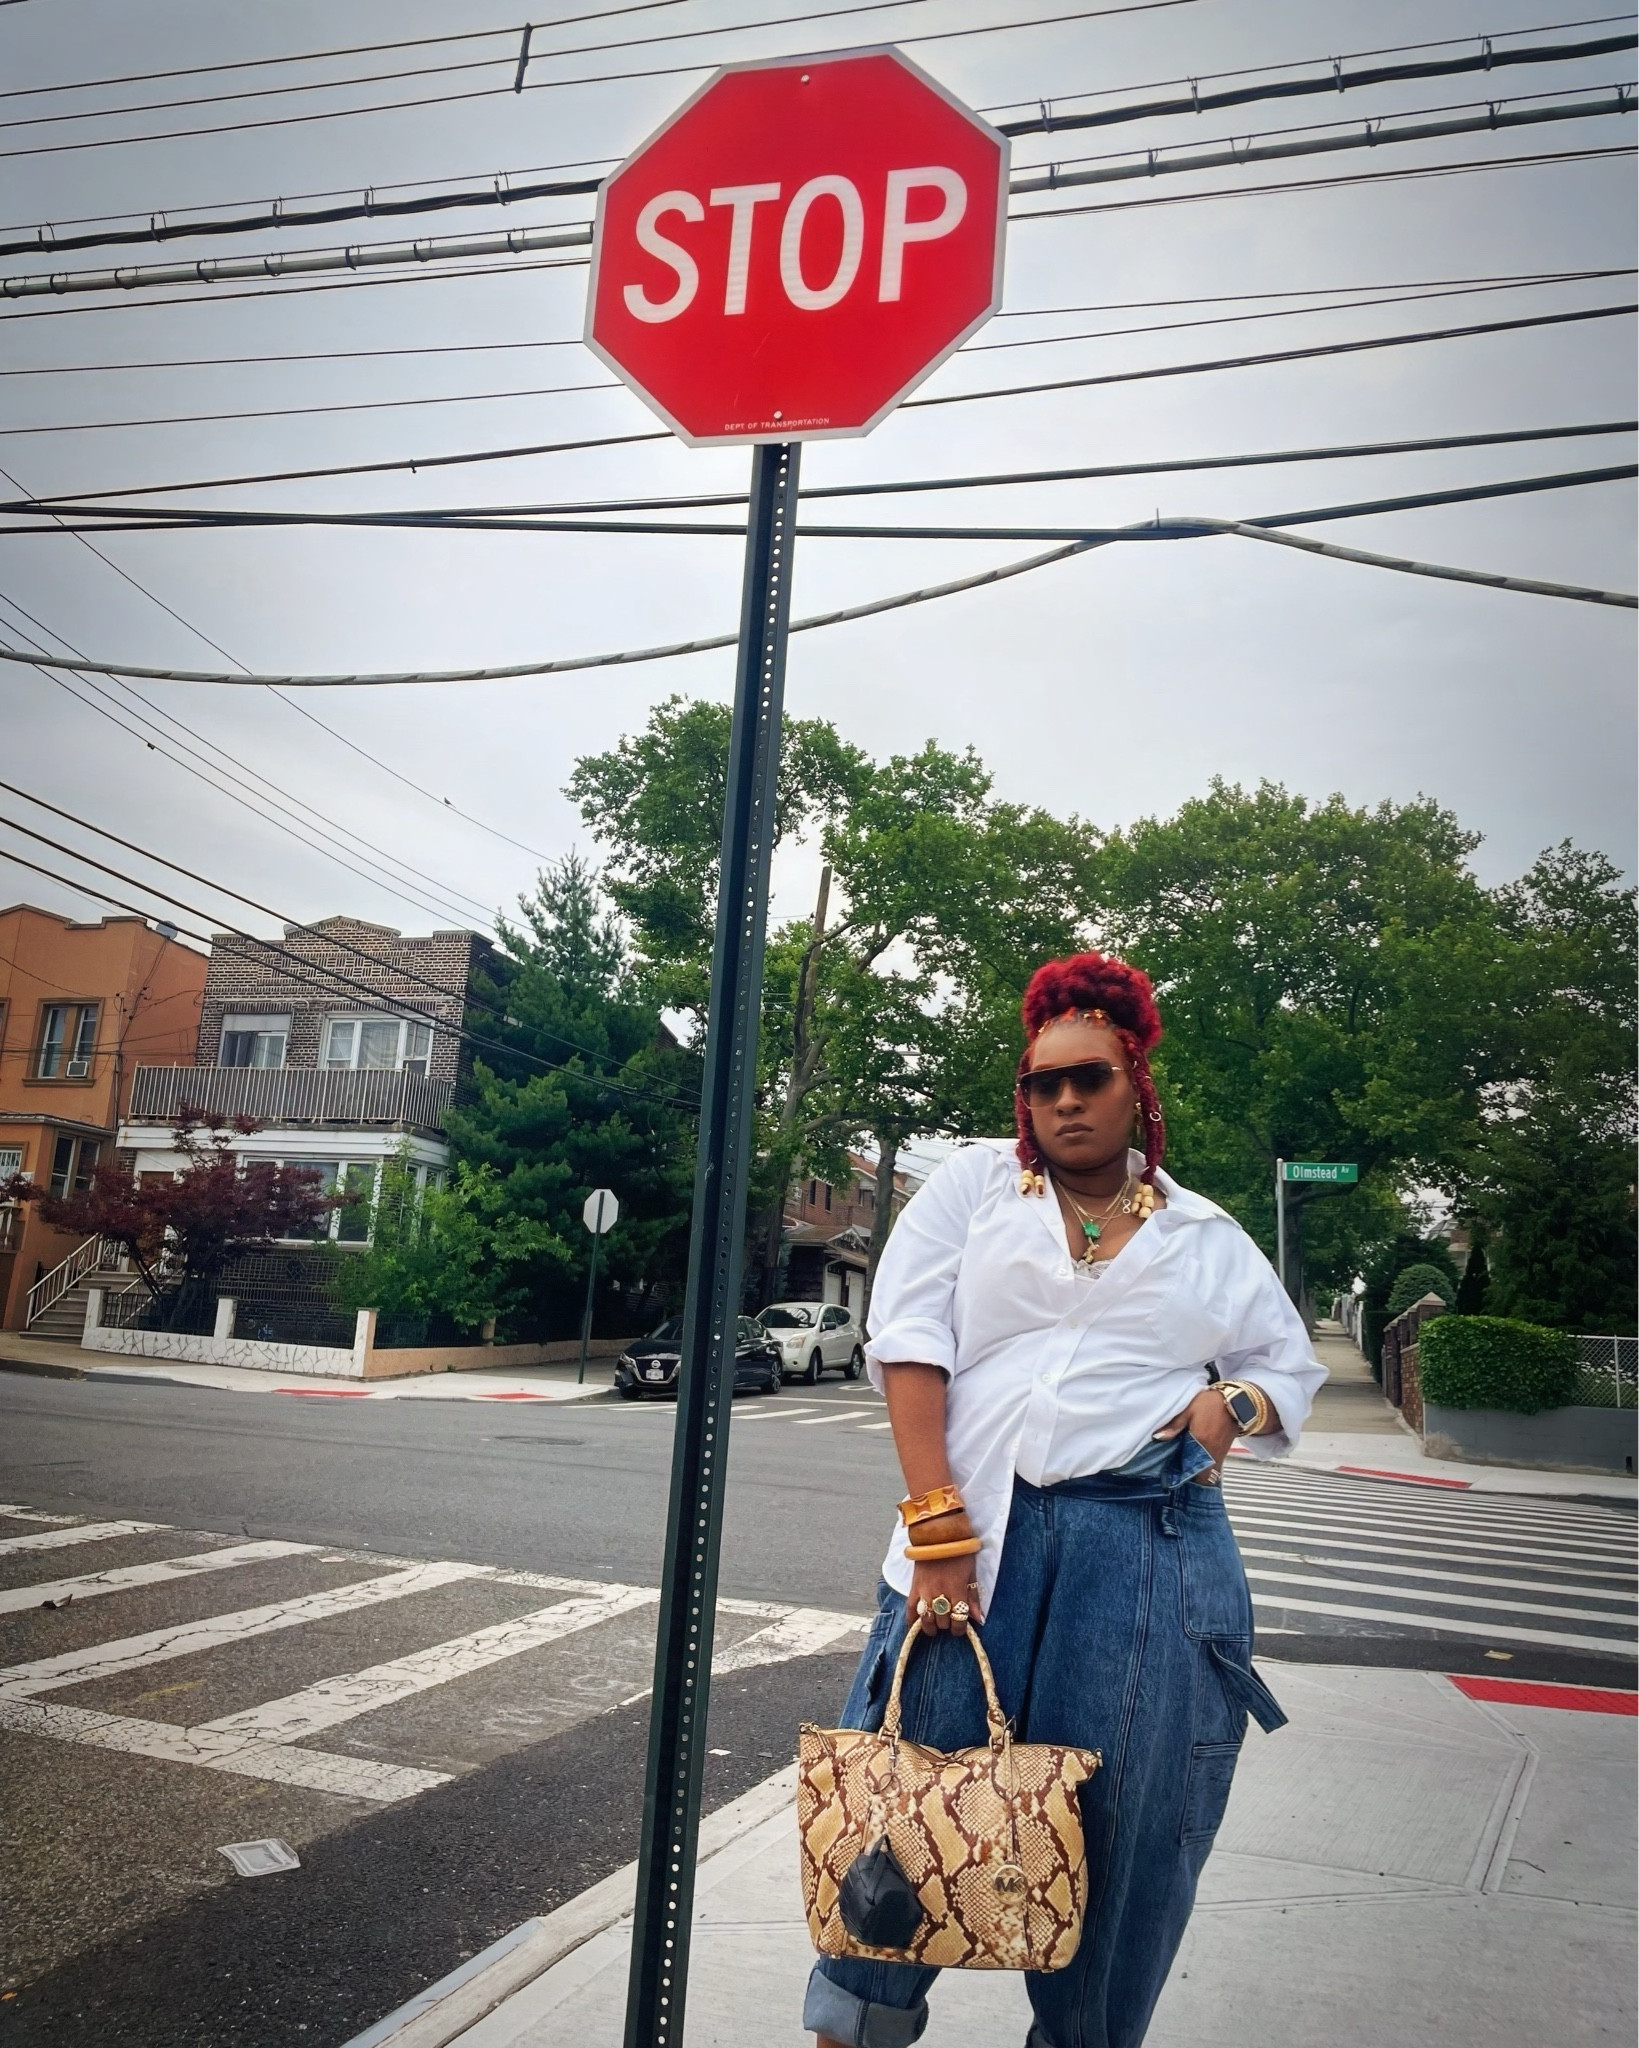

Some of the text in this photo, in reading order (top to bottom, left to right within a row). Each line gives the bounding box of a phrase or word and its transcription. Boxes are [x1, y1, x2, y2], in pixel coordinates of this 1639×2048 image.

[623, 165, 968, 323] STOP
[724, 423, 745, 431] DEPT
[760, 418, 830, 428] TRANSPORTATION
[1293, 1165, 1337, 1179] Olmstead
[995, 1876, 1024, 1893] MK
